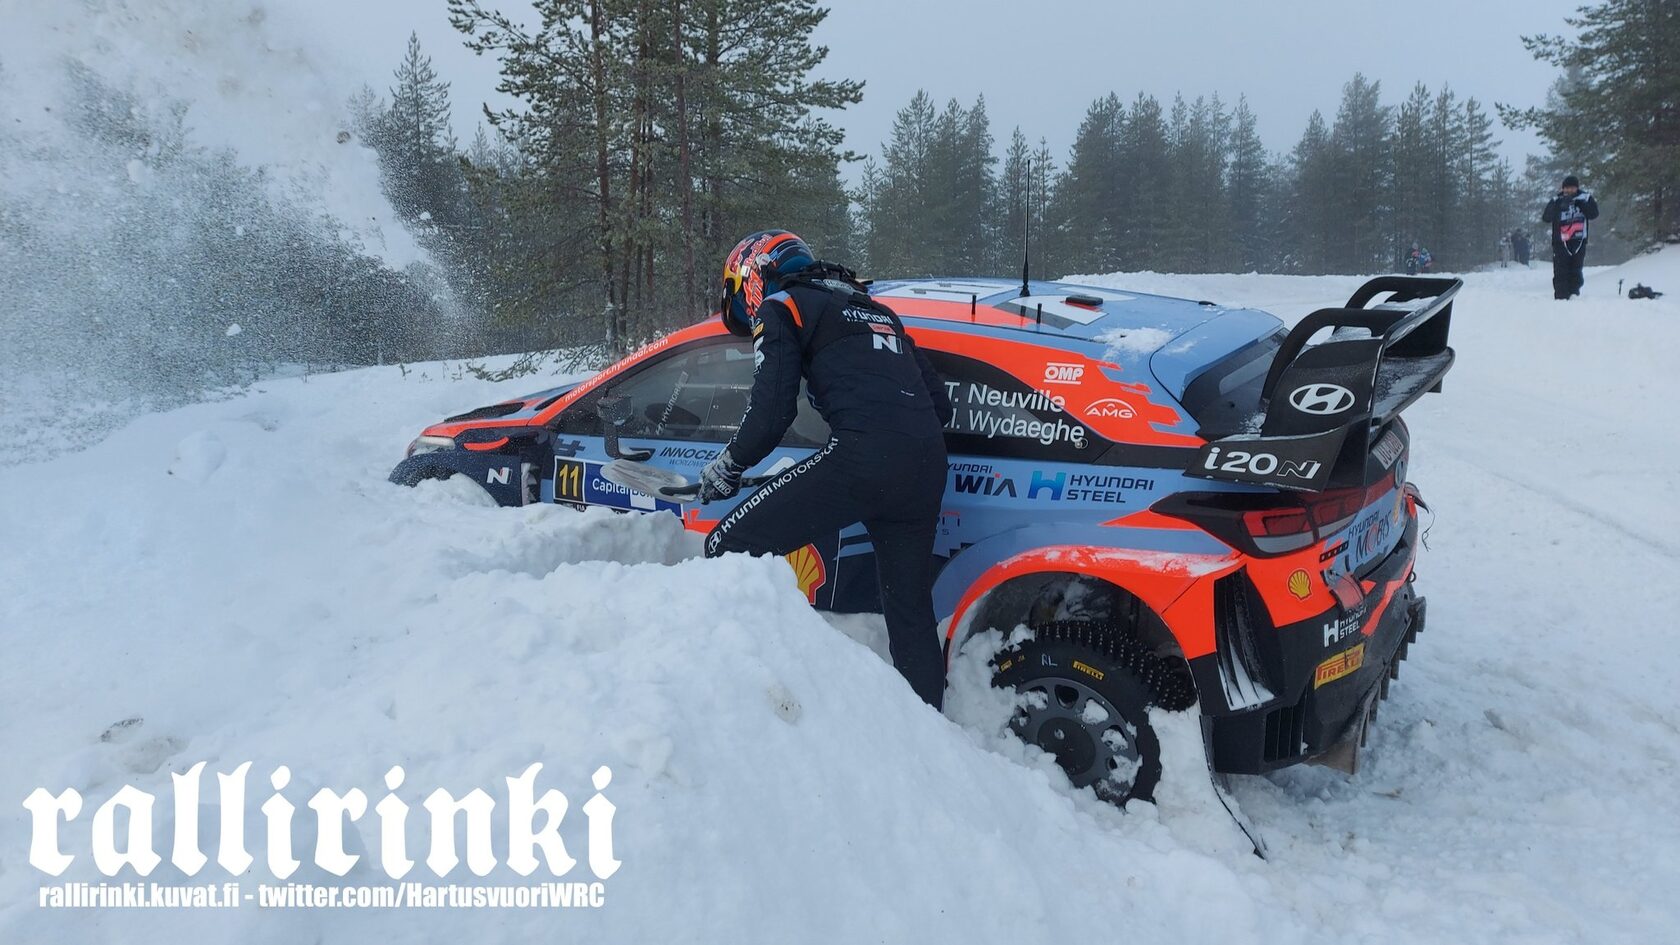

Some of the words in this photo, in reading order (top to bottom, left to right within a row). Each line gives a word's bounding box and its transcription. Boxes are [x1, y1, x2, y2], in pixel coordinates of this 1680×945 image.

[565, 338, 669, 402] motorsport.hyundai.com
[1044, 364, 1084, 382] OMP
[944, 381, 960, 402] T.
[967, 383, 1066, 413] Neuville
[1086, 407, 1133, 418] AMG
[968, 409, 1085, 445] Wydaeghe
[946, 463, 993, 474] YUNDAI
[1204, 446, 1279, 475] i20
[559, 464, 579, 496] 11
[955, 473, 1017, 498] WIA
[1069, 474, 1155, 491] HYUNDAI
[1066, 489, 1126, 504] STEEL
[721, 485, 774, 533] HYUNDAI
[1339, 620, 1360, 640] STEEL
[1041, 653, 1058, 667] RL
[1073, 660, 1105, 681] PIRELLI
